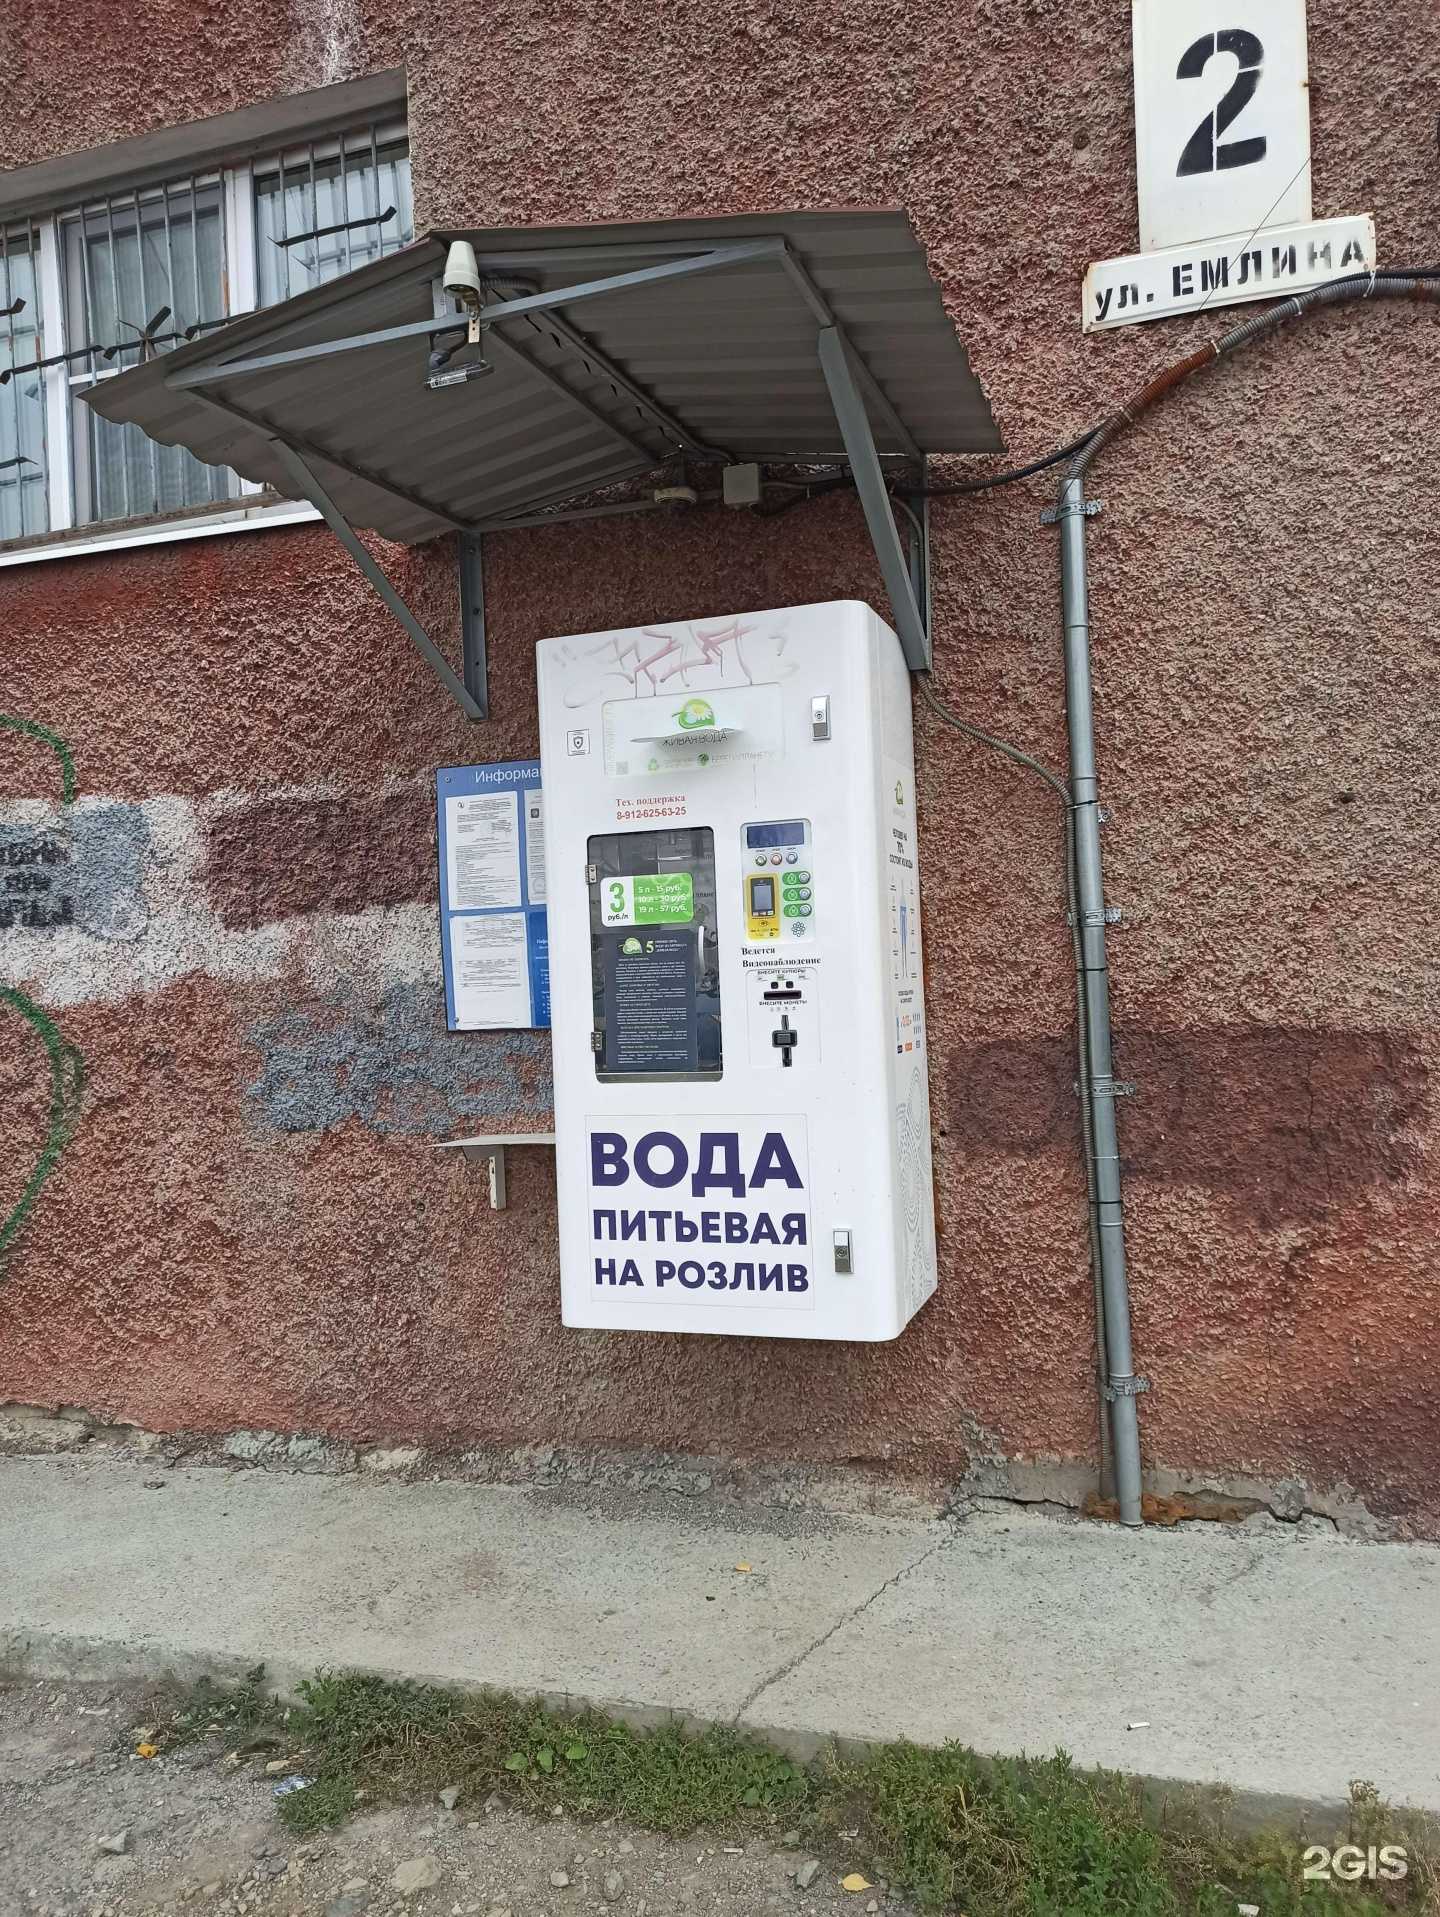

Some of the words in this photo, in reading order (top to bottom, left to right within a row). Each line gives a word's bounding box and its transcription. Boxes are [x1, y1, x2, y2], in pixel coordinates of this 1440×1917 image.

[1176, 28, 1266, 177] 2
[1095, 284, 1154, 322] ул.
[1172, 239, 1366, 298] ЕМЛИНА
[475, 768, 540, 784] Информа
[616, 799, 634, 807] Тех.
[636, 795, 686, 806] поддержка
[616, 806, 687, 820] 8-912-625-63-25
[656, 884, 664, 893] 15
[665, 884, 682, 894] руб.
[609, 882, 625, 913] 3
[671, 893, 688, 904] руб.
[639, 905, 648, 914] 19
[660, 904, 669, 913] 57
[670, 904, 689, 914] руб.
[607, 913, 629, 921] руб./л
[646, 940, 654, 953] 5
[741, 947, 775, 956] Ведется
[742, 958, 821, 968] Видеонаблюдение
[591, 1131, 804, 1198] ВОДА
[593, 1209, 808, 1246] ПИТЬЕВАЯ
[594, 1257, 644, 1287] НА
[655, 1260, 809, 1293] РОЗЛИВ
